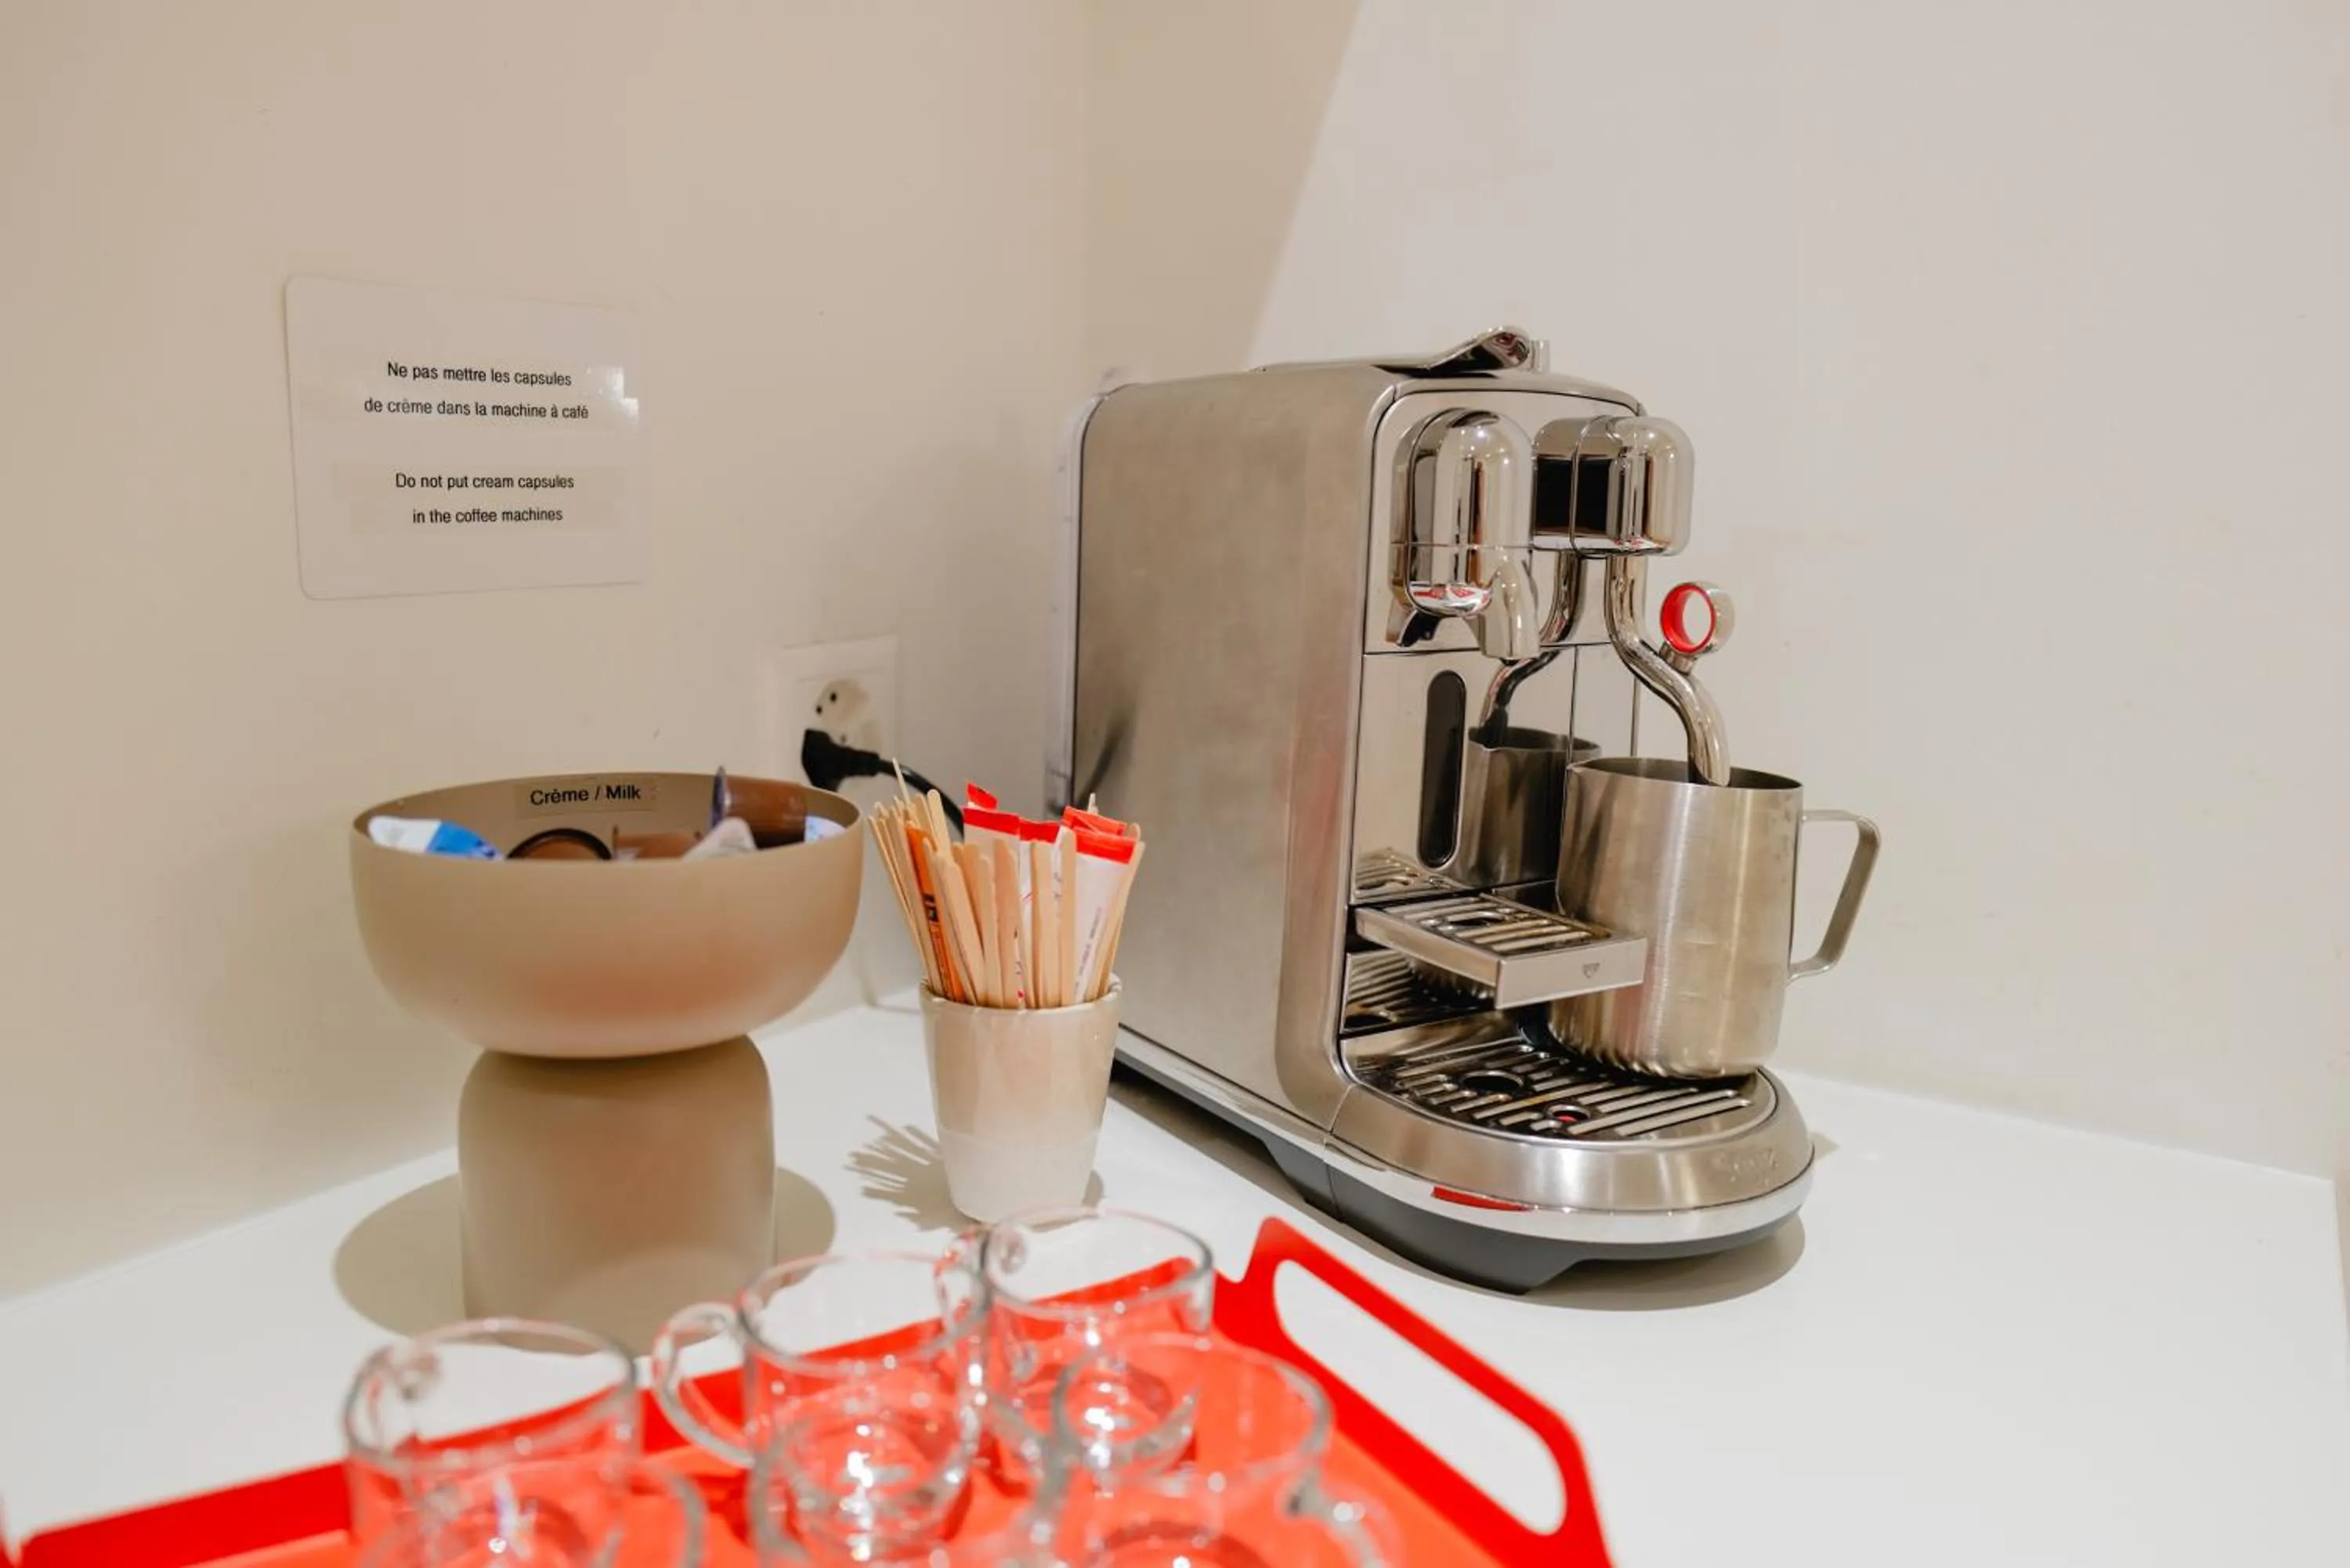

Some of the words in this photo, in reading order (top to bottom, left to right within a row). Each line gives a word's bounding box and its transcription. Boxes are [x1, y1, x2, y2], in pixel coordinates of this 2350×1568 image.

[387, 360, 409, 379] Ne
[411, 365, 439, 381] pas
[442, 367, 487, 383] mettre
[490, 367, 512, 385] les
[513, 371, 573, 388] capsules
[363, 396, 384, 414] de
[386, 399, 433, 415] crème
[436, 399, 472, 417] dans
[474, 400, 488, 417] la
[490, 402, 548, 418] machine
[550, 403, 559, 418] à
[561, 404, 589, 420] café
[395, 471, 417, 489] Do
[420, 475, 443, 489] not
[446, 475, 469, 492] put
[472, 475, 515, 490] cream
[517, 474, 575, 491] capsules
[412, 508, 426, 524] in
[428, 508, 452, 524] the
[454, 507, 498, 523] coffee
[501, 507, 564, 522] machines
[530, 787, 590, 806] Crème
[606, 783, 642, 800] Milk
